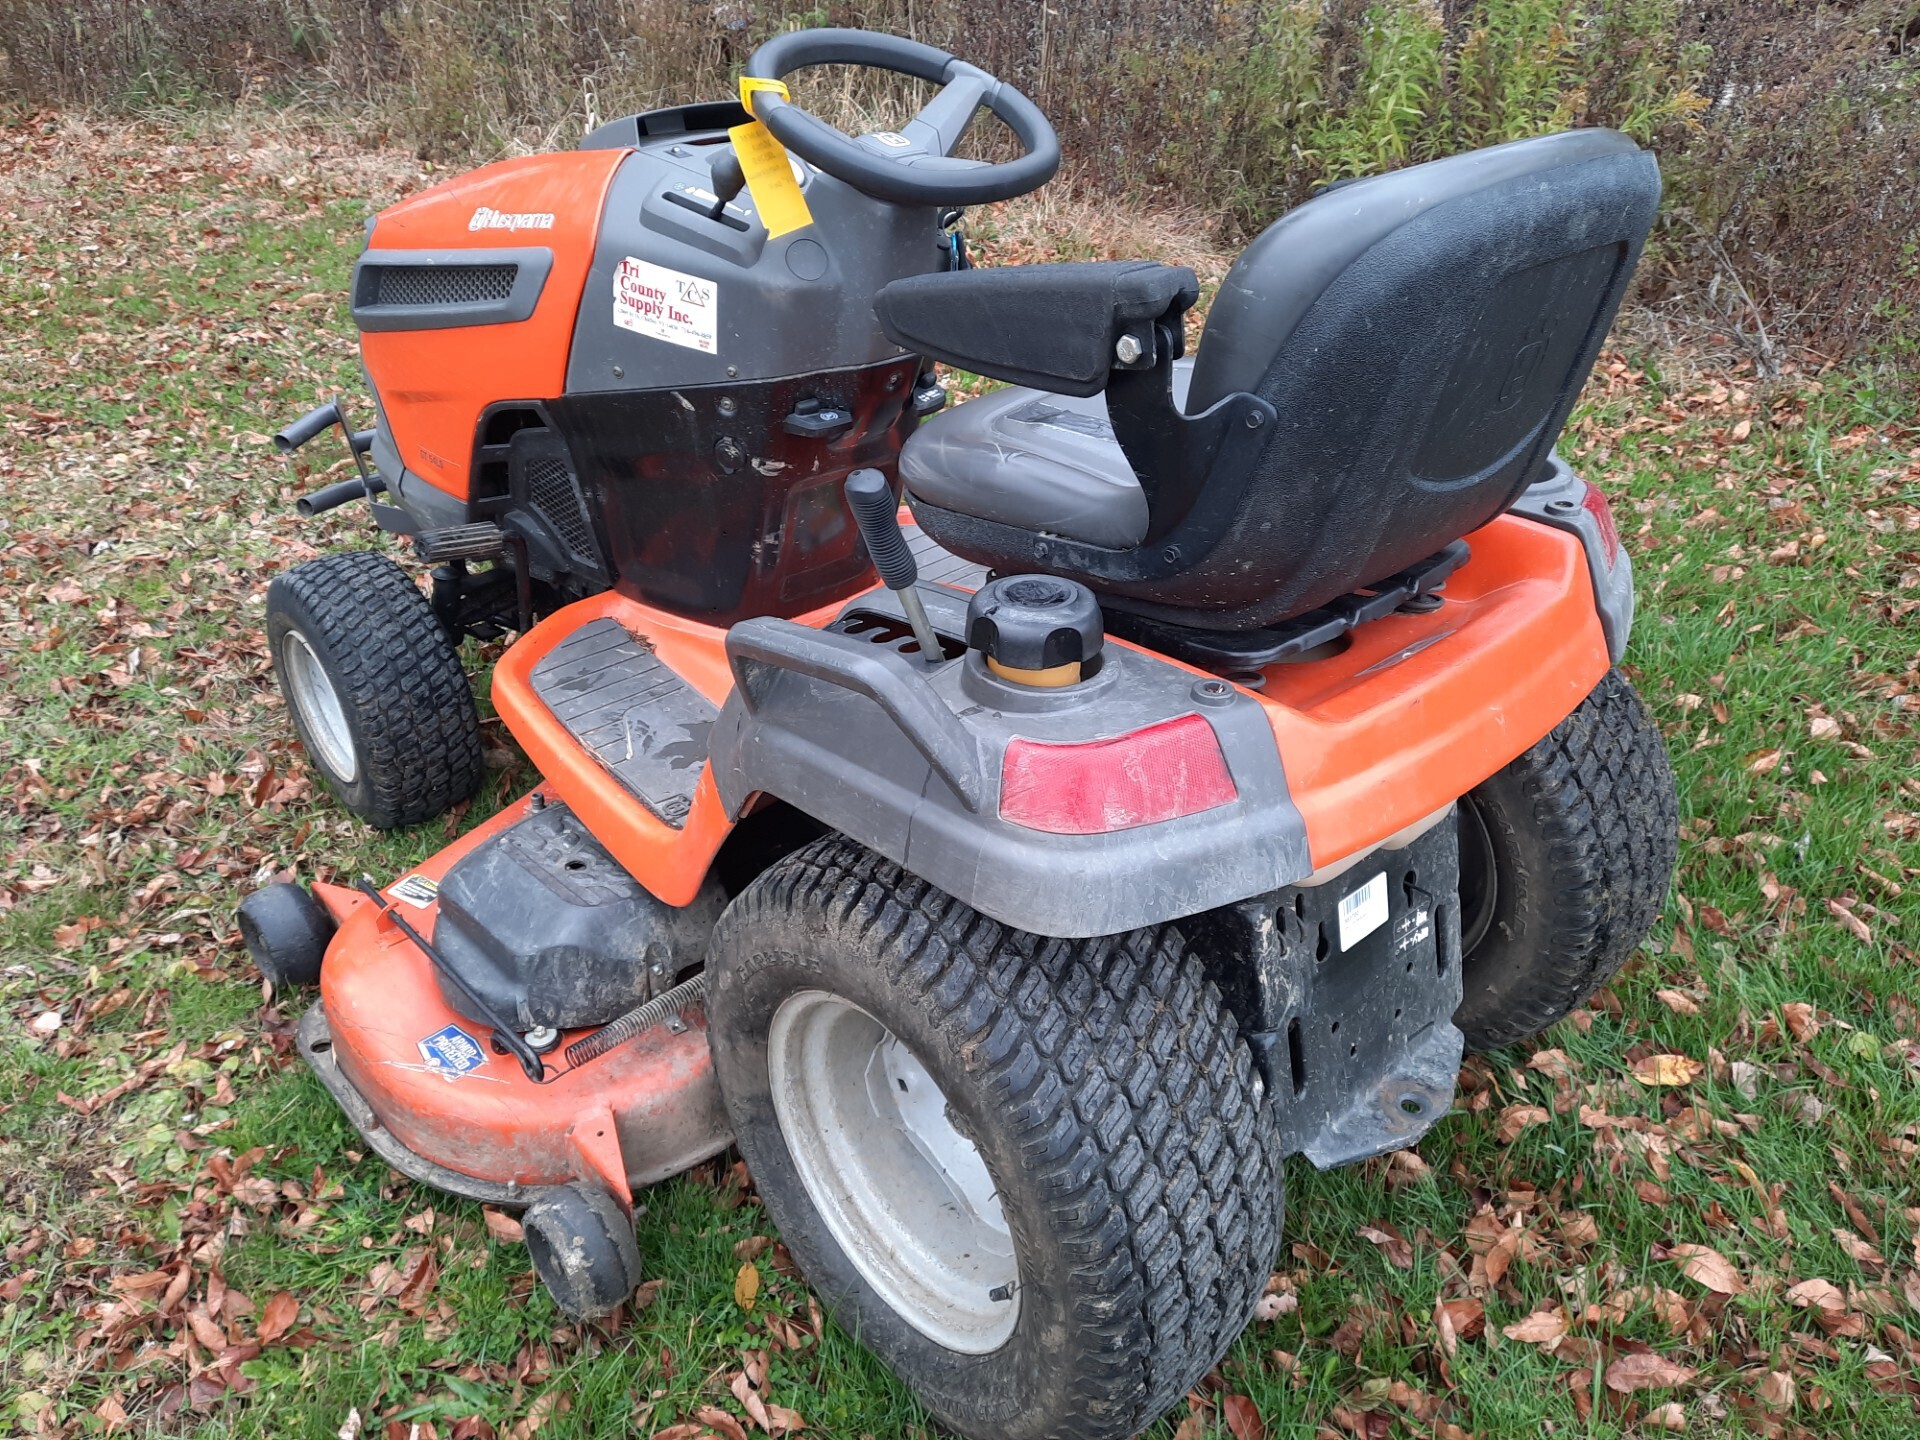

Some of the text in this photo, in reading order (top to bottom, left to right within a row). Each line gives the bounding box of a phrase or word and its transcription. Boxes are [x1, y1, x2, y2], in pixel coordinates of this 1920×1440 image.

[481, 208, 555, 232] Husqvarna
[619, 261, 639, 278] Tri
[620, 275, 667, 305] County
[620, 290, 664, 319] Supply
[668, 305, 693, 325] Inc.
[433, 1034, 471, 1070] PROTECTED
[449, 1034, 478, 1059] ARMOR
